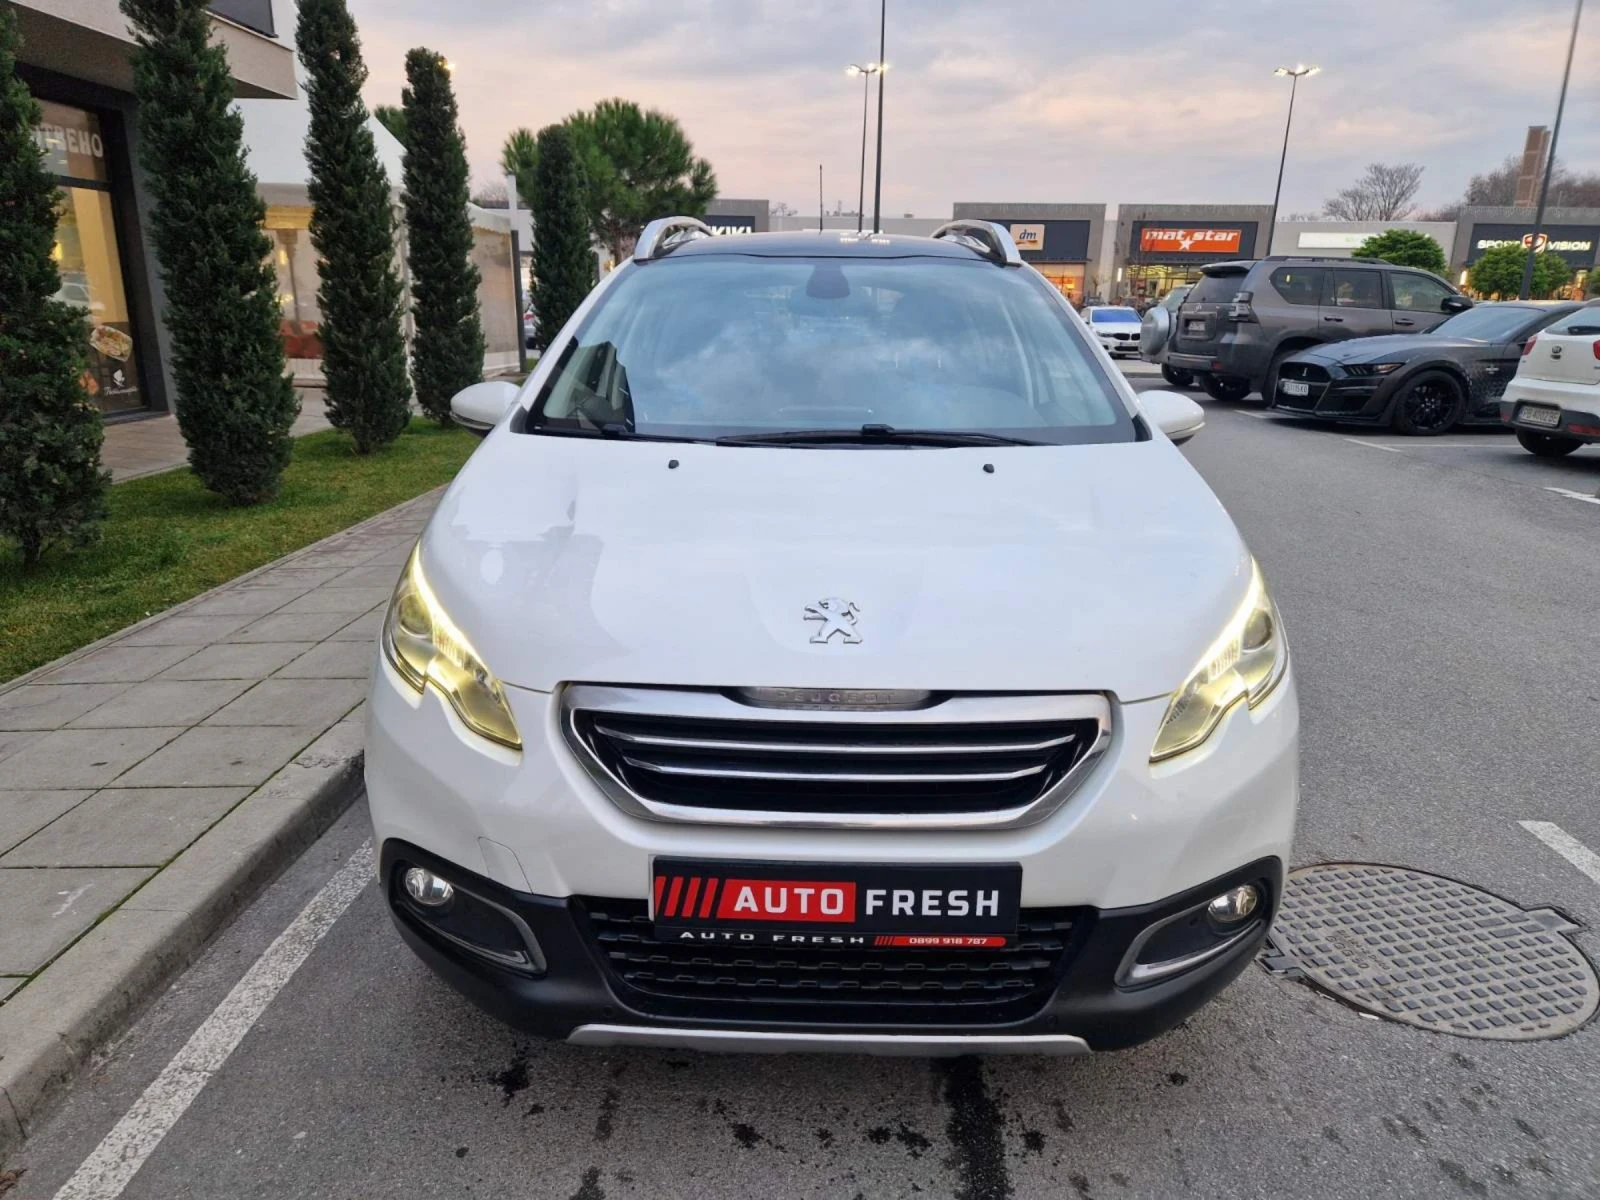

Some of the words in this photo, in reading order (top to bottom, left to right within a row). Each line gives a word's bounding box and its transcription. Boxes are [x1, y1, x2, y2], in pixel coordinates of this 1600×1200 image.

[1019, 229, 1037, 240] dm
[1145, 230, 1186, 241] mat
[1192, 230, 1238, 241] star
[1547, 241, 1592, 251] VISION
[733, 886, 844, 915] AUTO
[865, 889, 999, 917] FRESH
[680, 931, 755, 940] AUTO
[772, 934, 864, 944] FRESH
[909, 937, 940, 945] 0899
